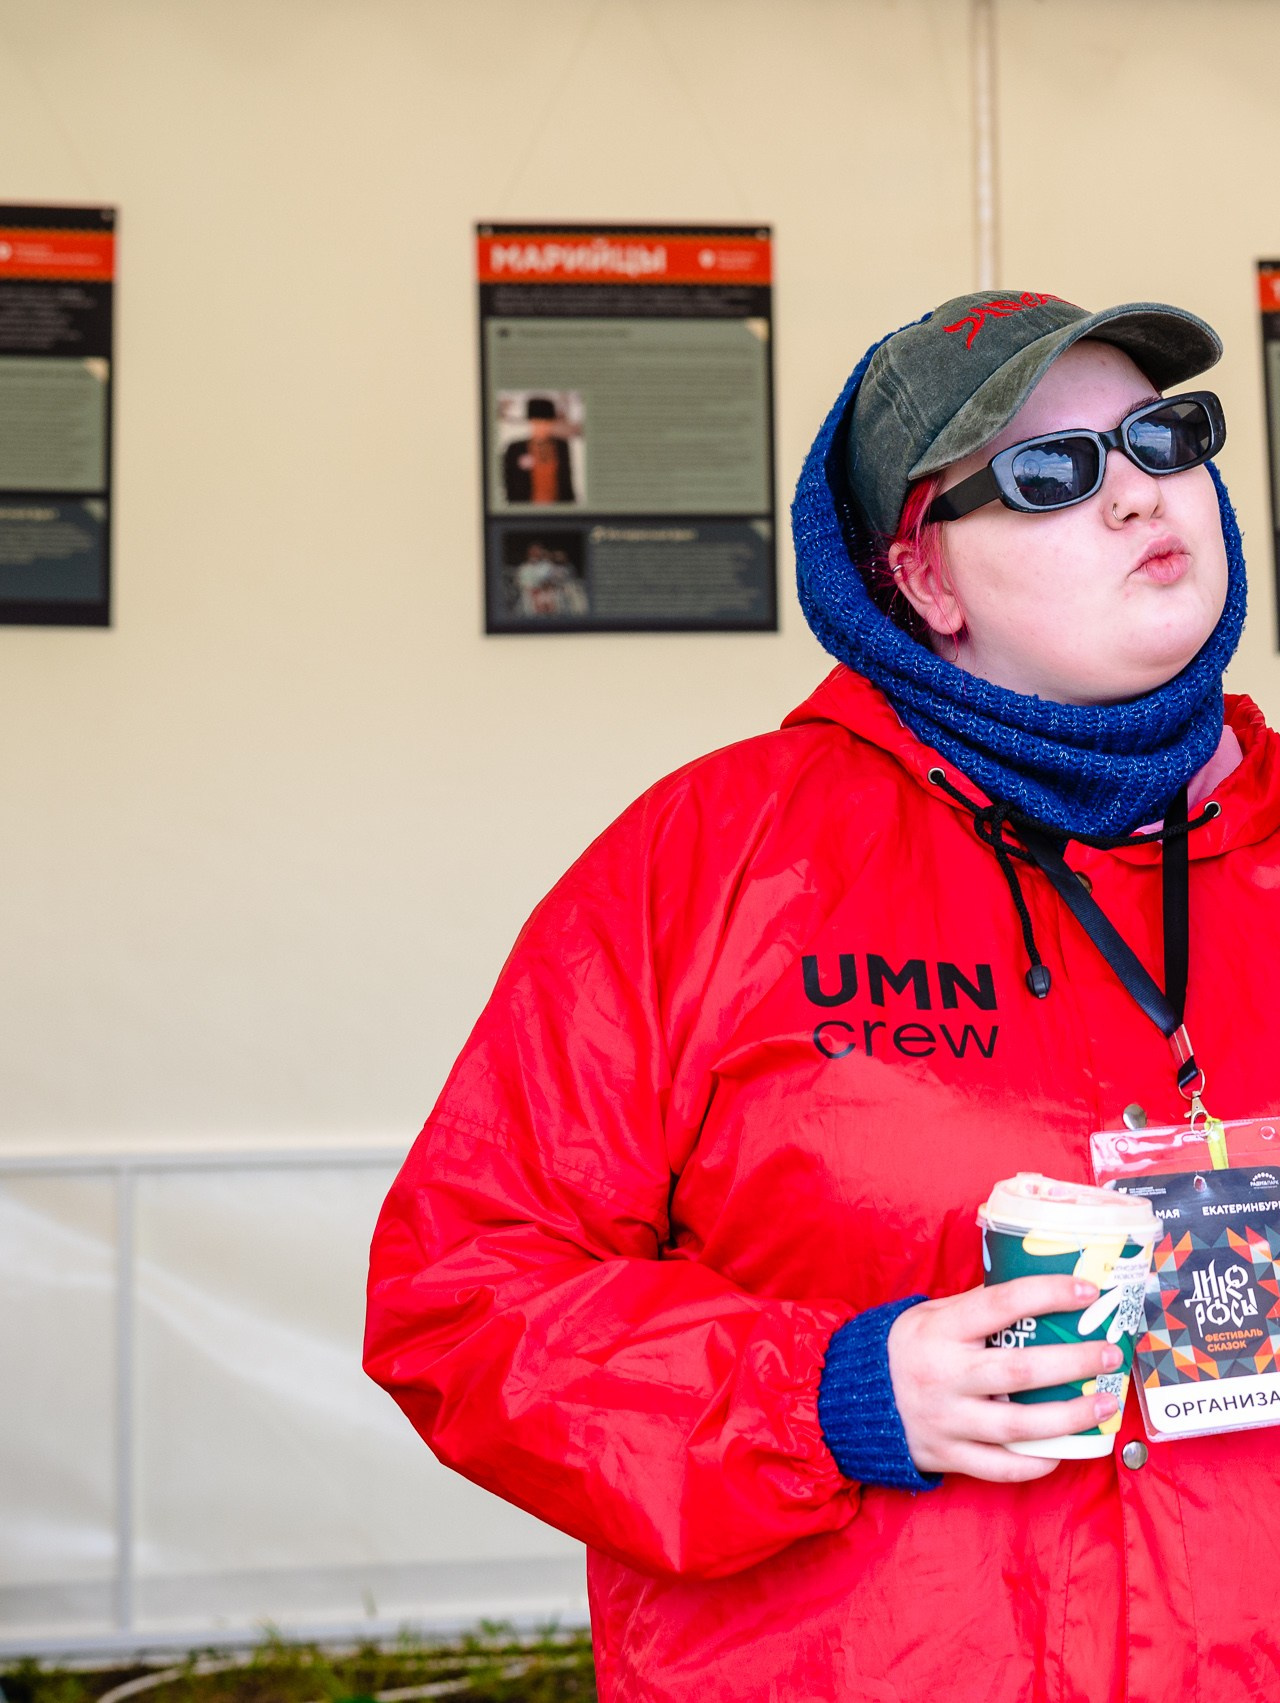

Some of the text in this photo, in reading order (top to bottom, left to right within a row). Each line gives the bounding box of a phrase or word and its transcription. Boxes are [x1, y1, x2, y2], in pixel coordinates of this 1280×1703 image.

[489, 238, 667, 277] МАРИЙЦЫ
[801, 953, 998, 1011] UMN
[812, 1020, 999, 1060] crew
[1155, 1207, 1181, 1220] МАЯ
[1205, 1327, 1263, 1343] ФЕСТИВАЛЬ
[1207, 1340, 1247, 1353] СКАЗОК
